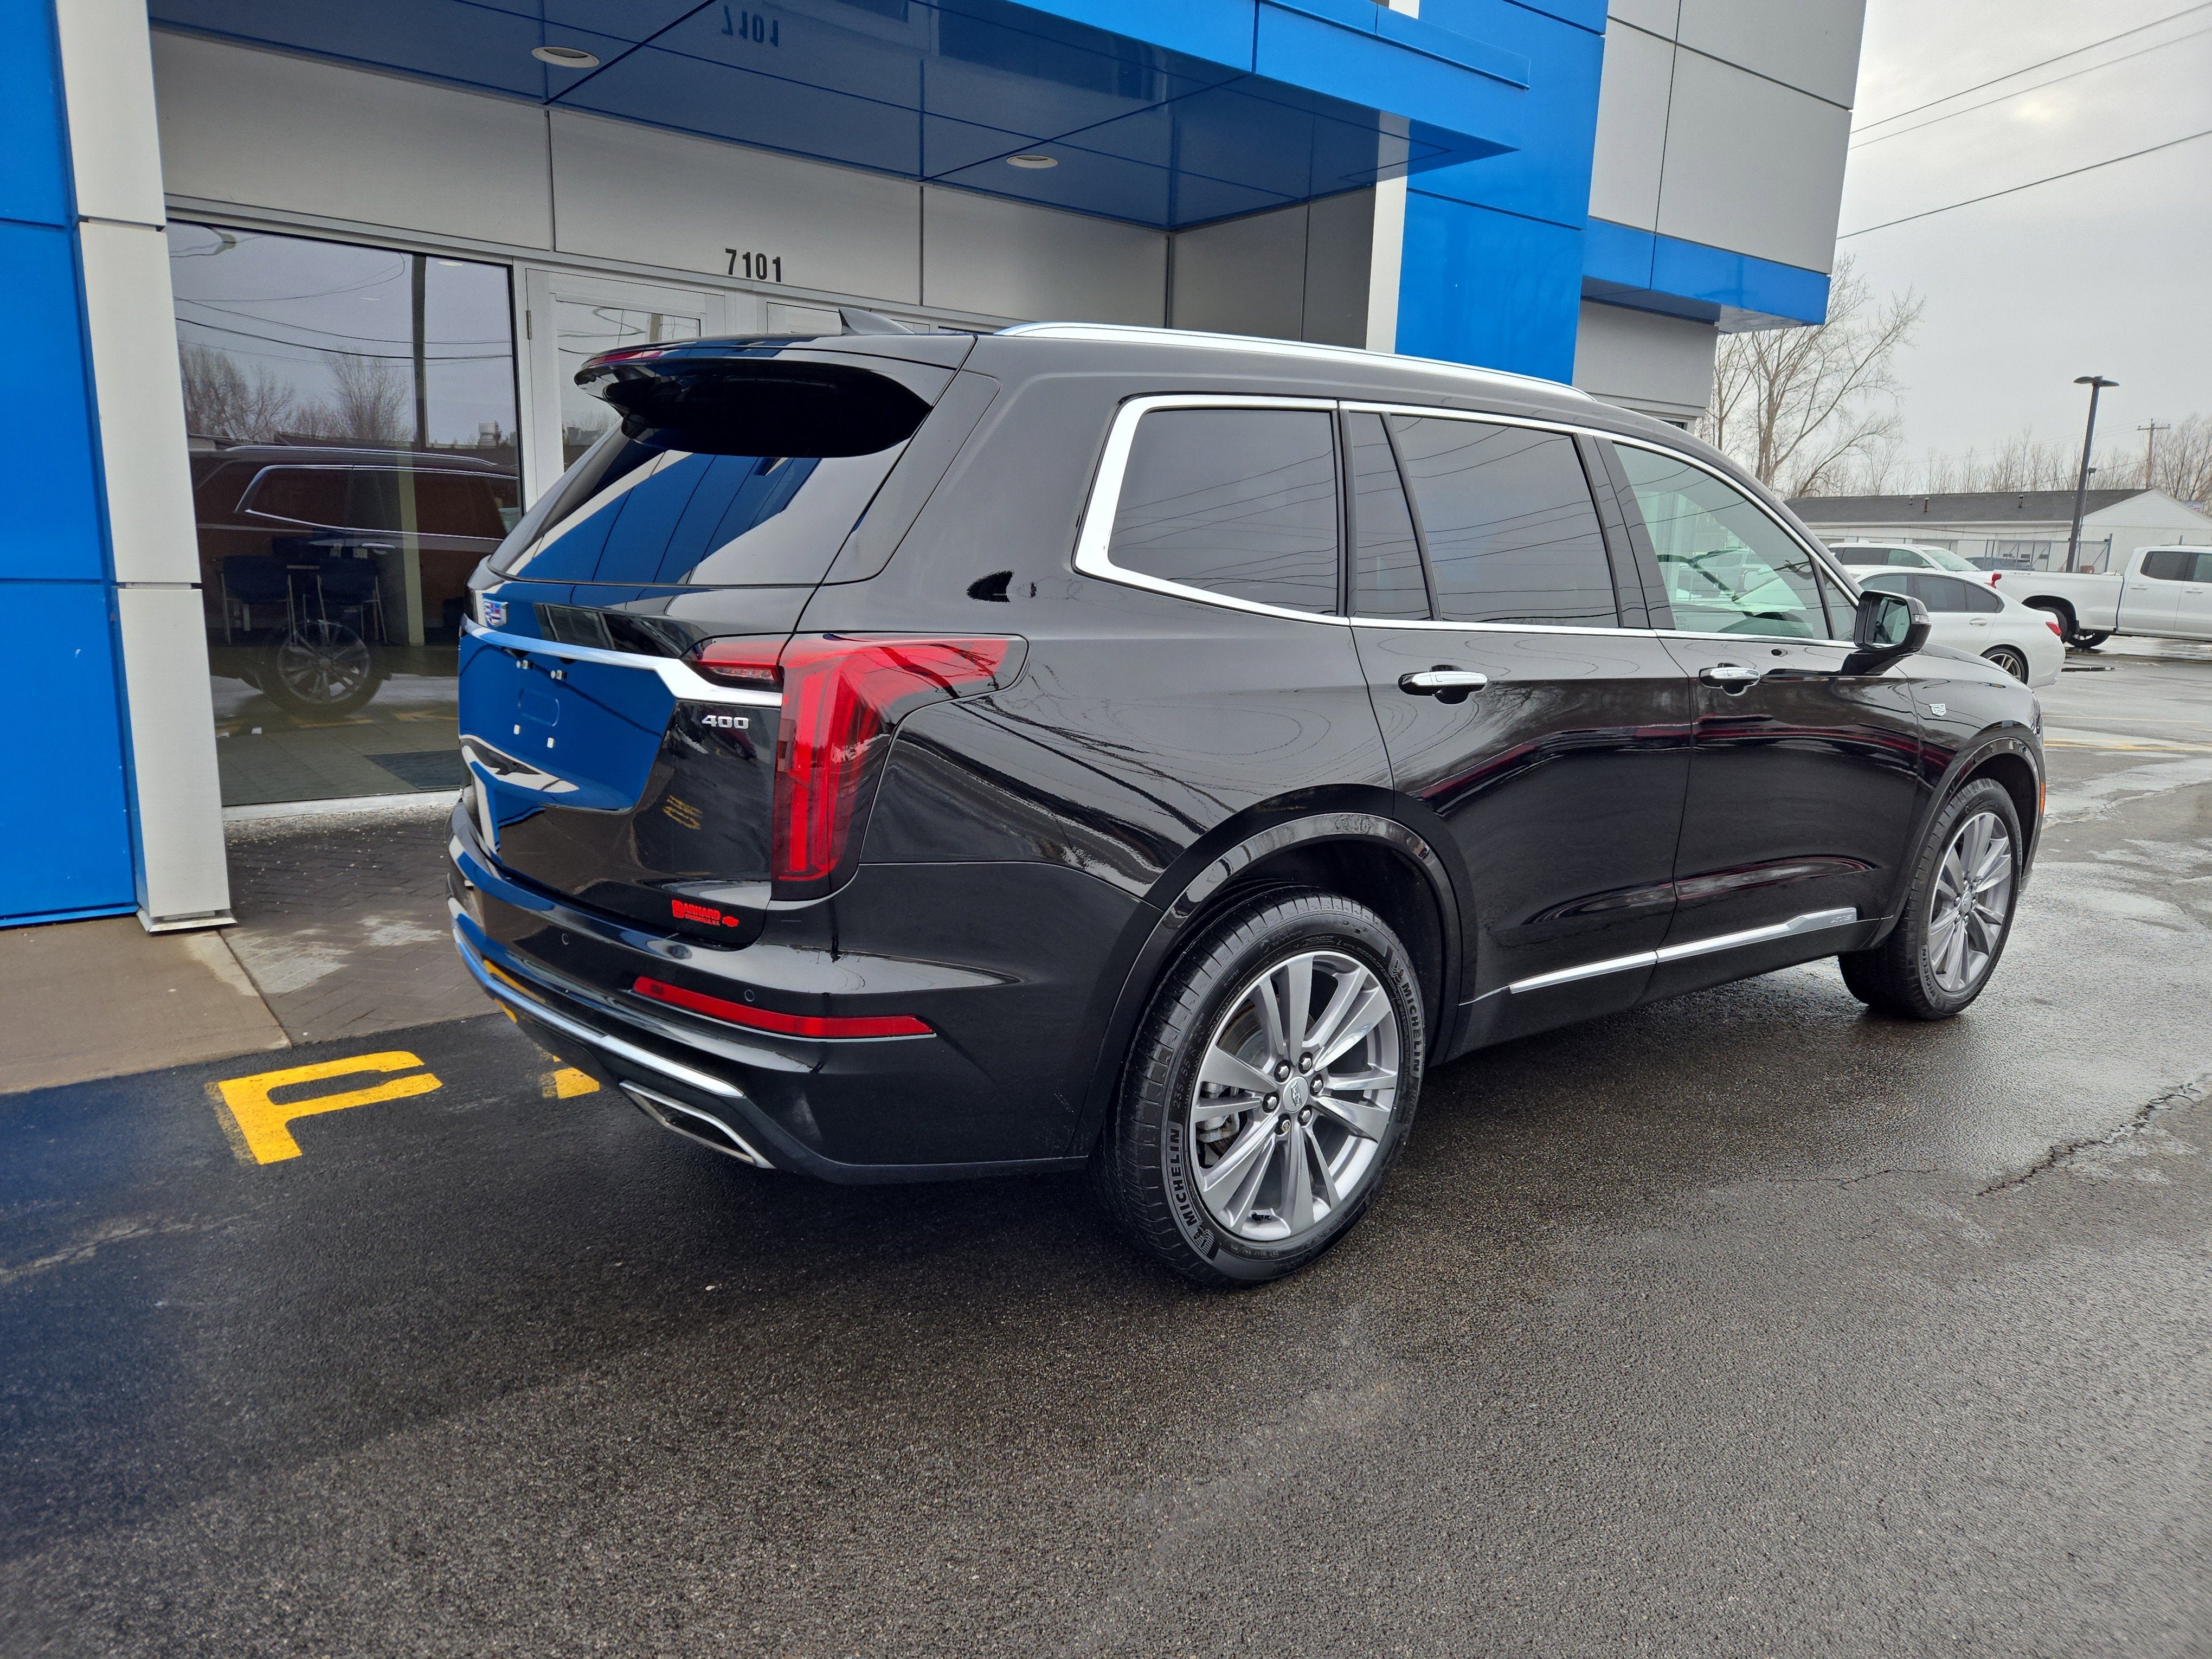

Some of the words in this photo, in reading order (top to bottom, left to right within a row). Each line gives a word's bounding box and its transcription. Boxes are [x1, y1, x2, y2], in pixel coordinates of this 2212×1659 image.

[725, 248, 781, 282] 7101
[702, 715, 749, 729] 400
[1922, 948, 1937, 997] MICHELIN
[1401, 982, 1421, 1072] MICHELIN
[1170, 1128, 1197, 1226] MICHELIN
